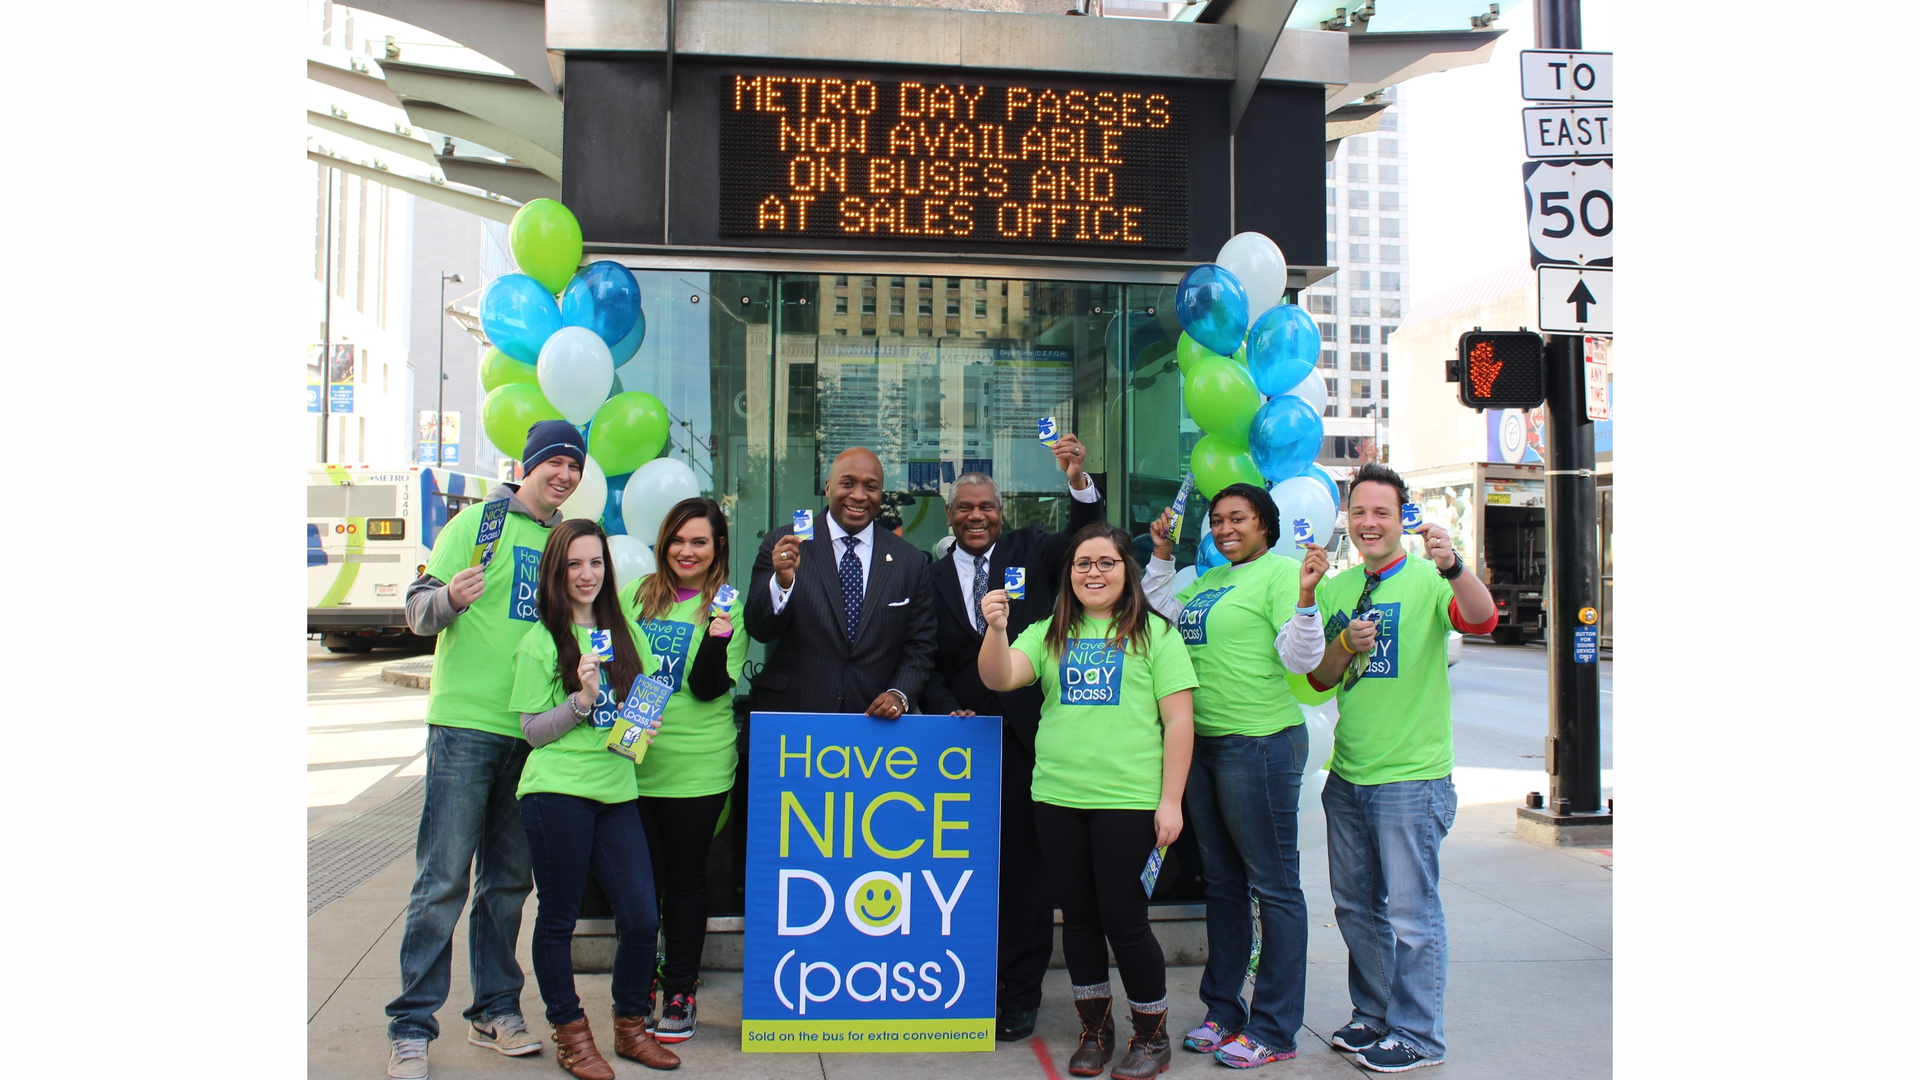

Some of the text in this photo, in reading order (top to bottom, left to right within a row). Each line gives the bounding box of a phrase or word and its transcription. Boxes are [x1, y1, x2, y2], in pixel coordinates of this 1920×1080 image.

[1548, 62, 1595, 91] TO
[735, 75, 1170, 129] METRO DAY PASSES
[780, 116, 1123, 164] NOW AVAILABLE
[1538, 117, 1608, 146] EAST
[790, 156, 1114, 202] ON BUSES AND
[759, 194, 1143, 241] AT SALES OFFICE
[1540, 189, 1613, 239] 50
[1590, 367, 1603, 383] ANY
[1590, 386, 1604, 402] TIME
[483, 506, 506, 521] NICE
[485, 502, 502, 512] Have
[379, 521, 391, 535] 11
[520, 549, 541, 565] Hav
[520, 563, 540, 583] NI
[1384, 608, 1393, 617] a
[640, 619, 687, 636] Have a
[1071, 640, 1106, 650] Have
[1067, 650, 1118, 665] NICE
[1365, 658, 1391, 675] ass)
[638, 677, 659, 692] Have
[633, 685, 665, 707] NICE
[1067, 685, 1113, 703] (pass)
[623, 708, 653, 728] (pass)
[779, 734, 972, 780] Have a
[779, 790, 971, 860] NICE
[773, 948, 966, 1015] (pass)
[748, 1029, 989, 1042] Sold on the bus for extra convenience!
